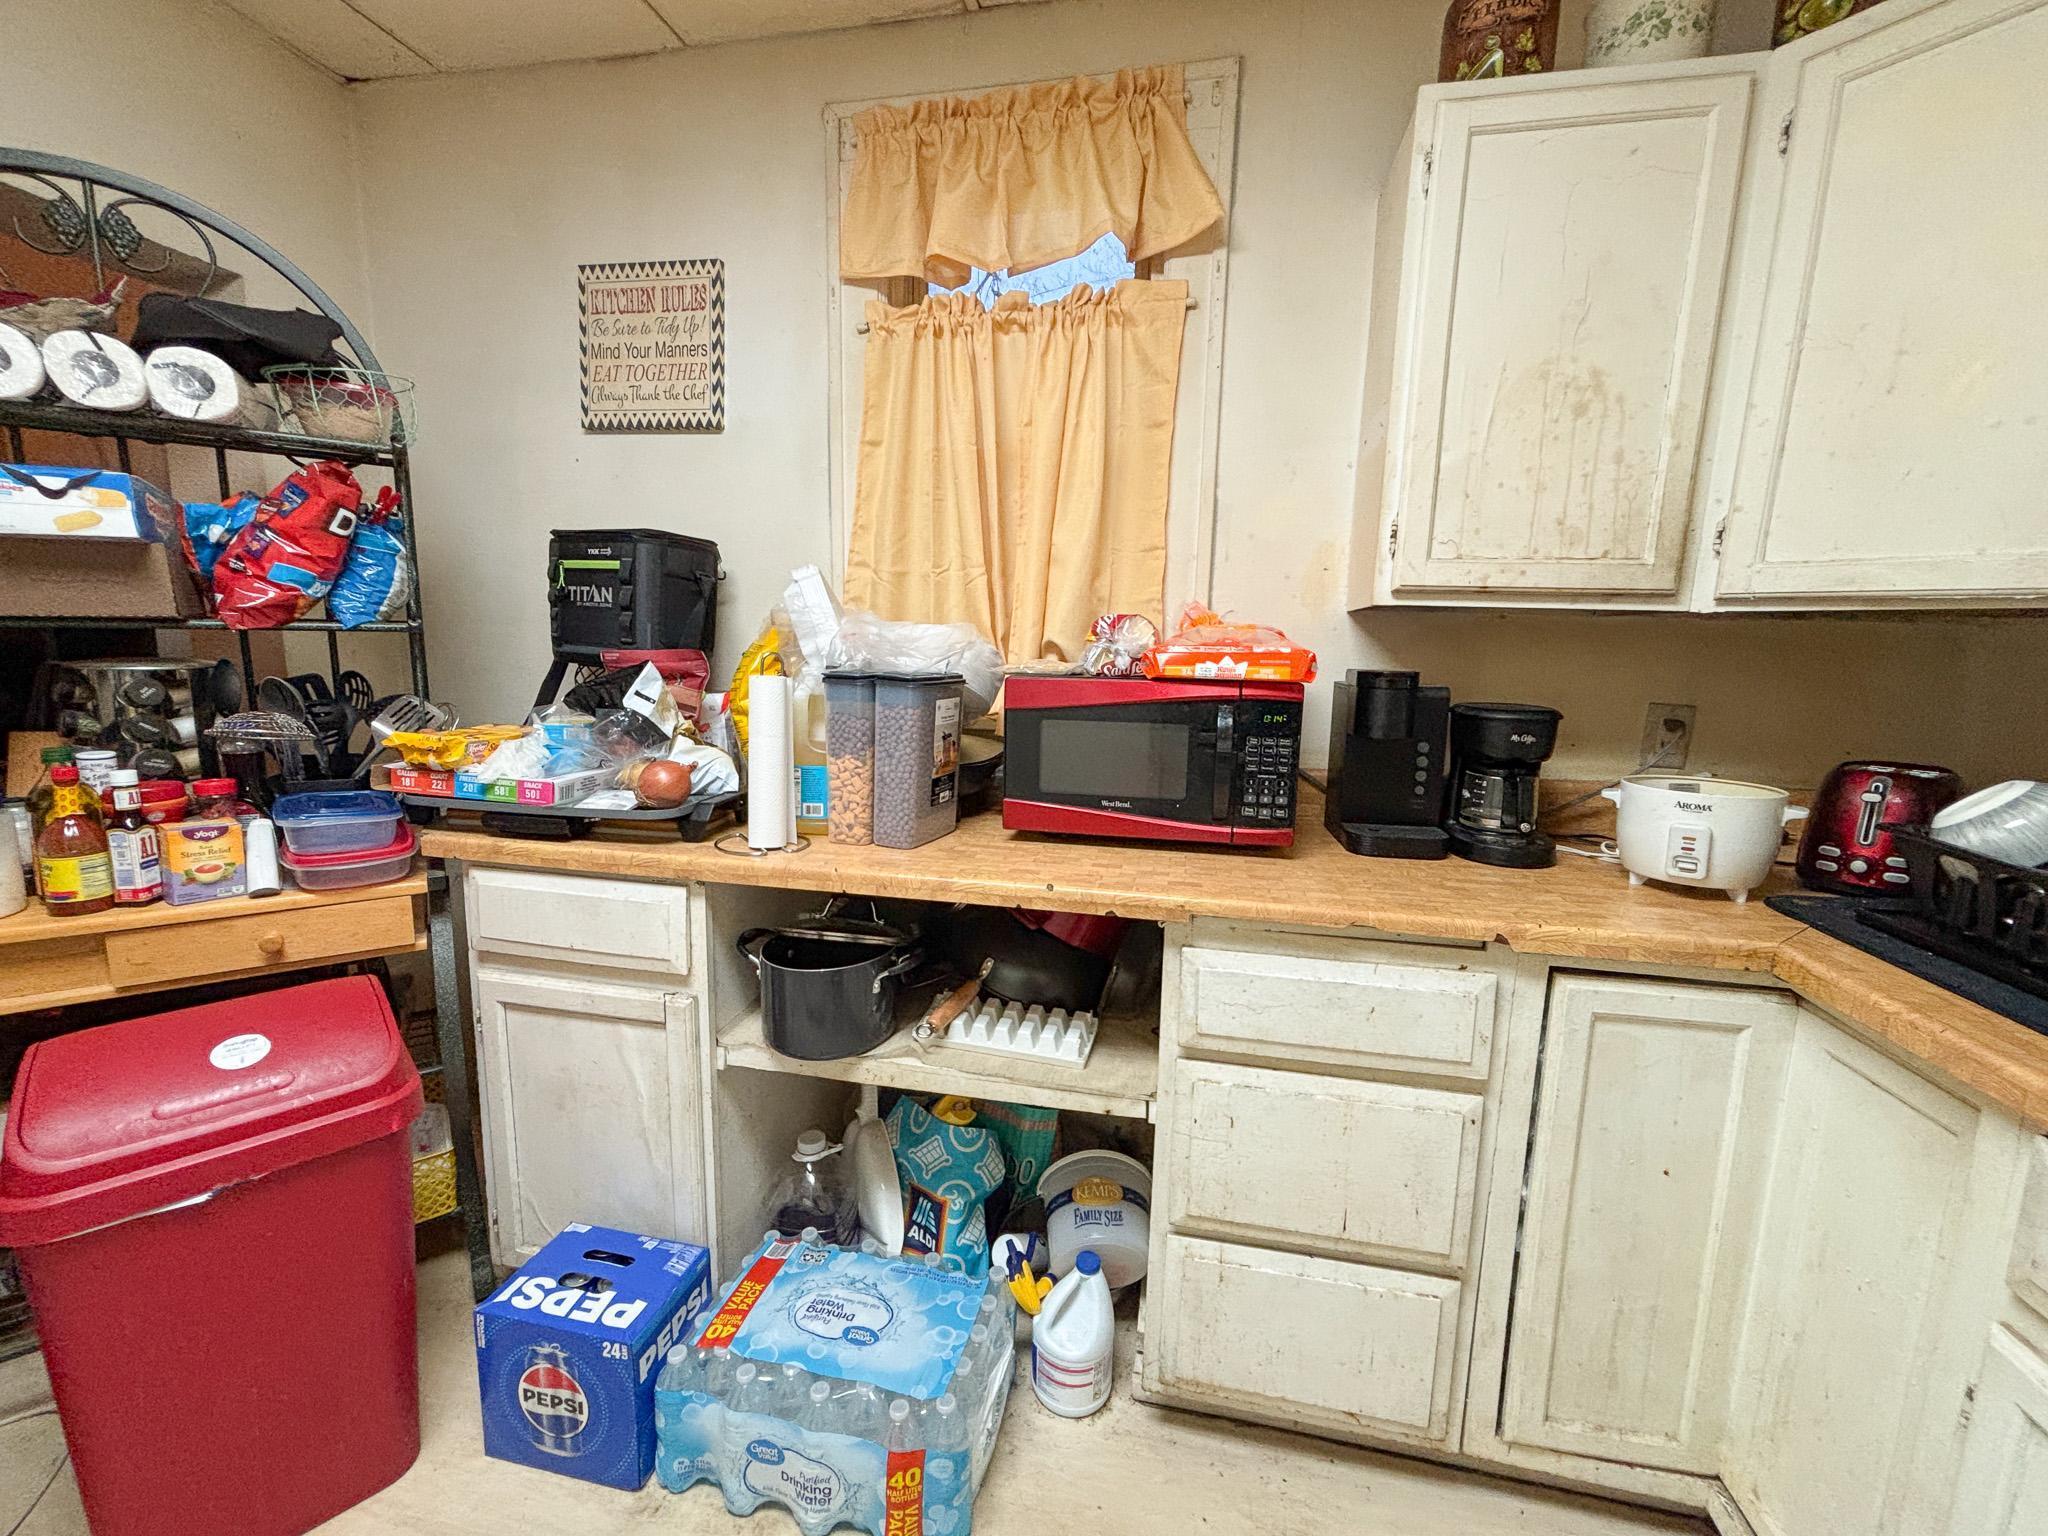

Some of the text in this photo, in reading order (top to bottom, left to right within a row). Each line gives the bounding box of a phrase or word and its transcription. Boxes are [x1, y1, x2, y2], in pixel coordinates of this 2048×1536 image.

[590, 283, 707, 315] KITCHEN RULES
[591, 315, 707, 342] Be Sure to Tidy Up!
[591, 341, 708, 360] Mind Your Manners
[592, 363, 708, 383] EAT TOGETHER
[591, 383, 709, 409] Always Thank the Chef
[567, 584, 613, 603] TITAN
[1129, 660, 1144, 677] Le
[401, 777, 442, 790] 18 22
[462, 783, 474, 793] 20
[525, 789, 537, 799] 50
[1101, 799, 1131, 808] West Bend
[1674, 800, 1713, 812] AROMA
[193, 829, 219, 839] yogi
[1076, 1184, 1120, 1200] KEMPS
[1074, 1207, 1124, 1228] FAMILY SIZE
[907, 1224, 936, 1252] ALDI
[493, 1275, 648, 1329] PEPSI
[724, 1280, 755, 1310] VALUE
[738, 1283, 766, 1310] PACK
[809, 1297, 845, 1312] Water
[805, 1304, 856, 1322] Drinking
[638, 1276, 709, 1385] PEPSI
[706, 1324, 737, 1339] 40
[602, 1341, 620, 1360] 24
[522, 1387, 584, 1416] PEPSI
[750, 1442, 778, 1456] Great
[781, 1470, 833, 1498] Drinking
[888, 1466, 922, 1490] 40
[794, 1487, 833, 1506] Water
[886, 1488, 905, 1498] HALF
[890, 1491, 919, 1504] BOTTLES
[888, 1510, 904, 1536] PAC
[903, 1503, 920, 1536] VALU
